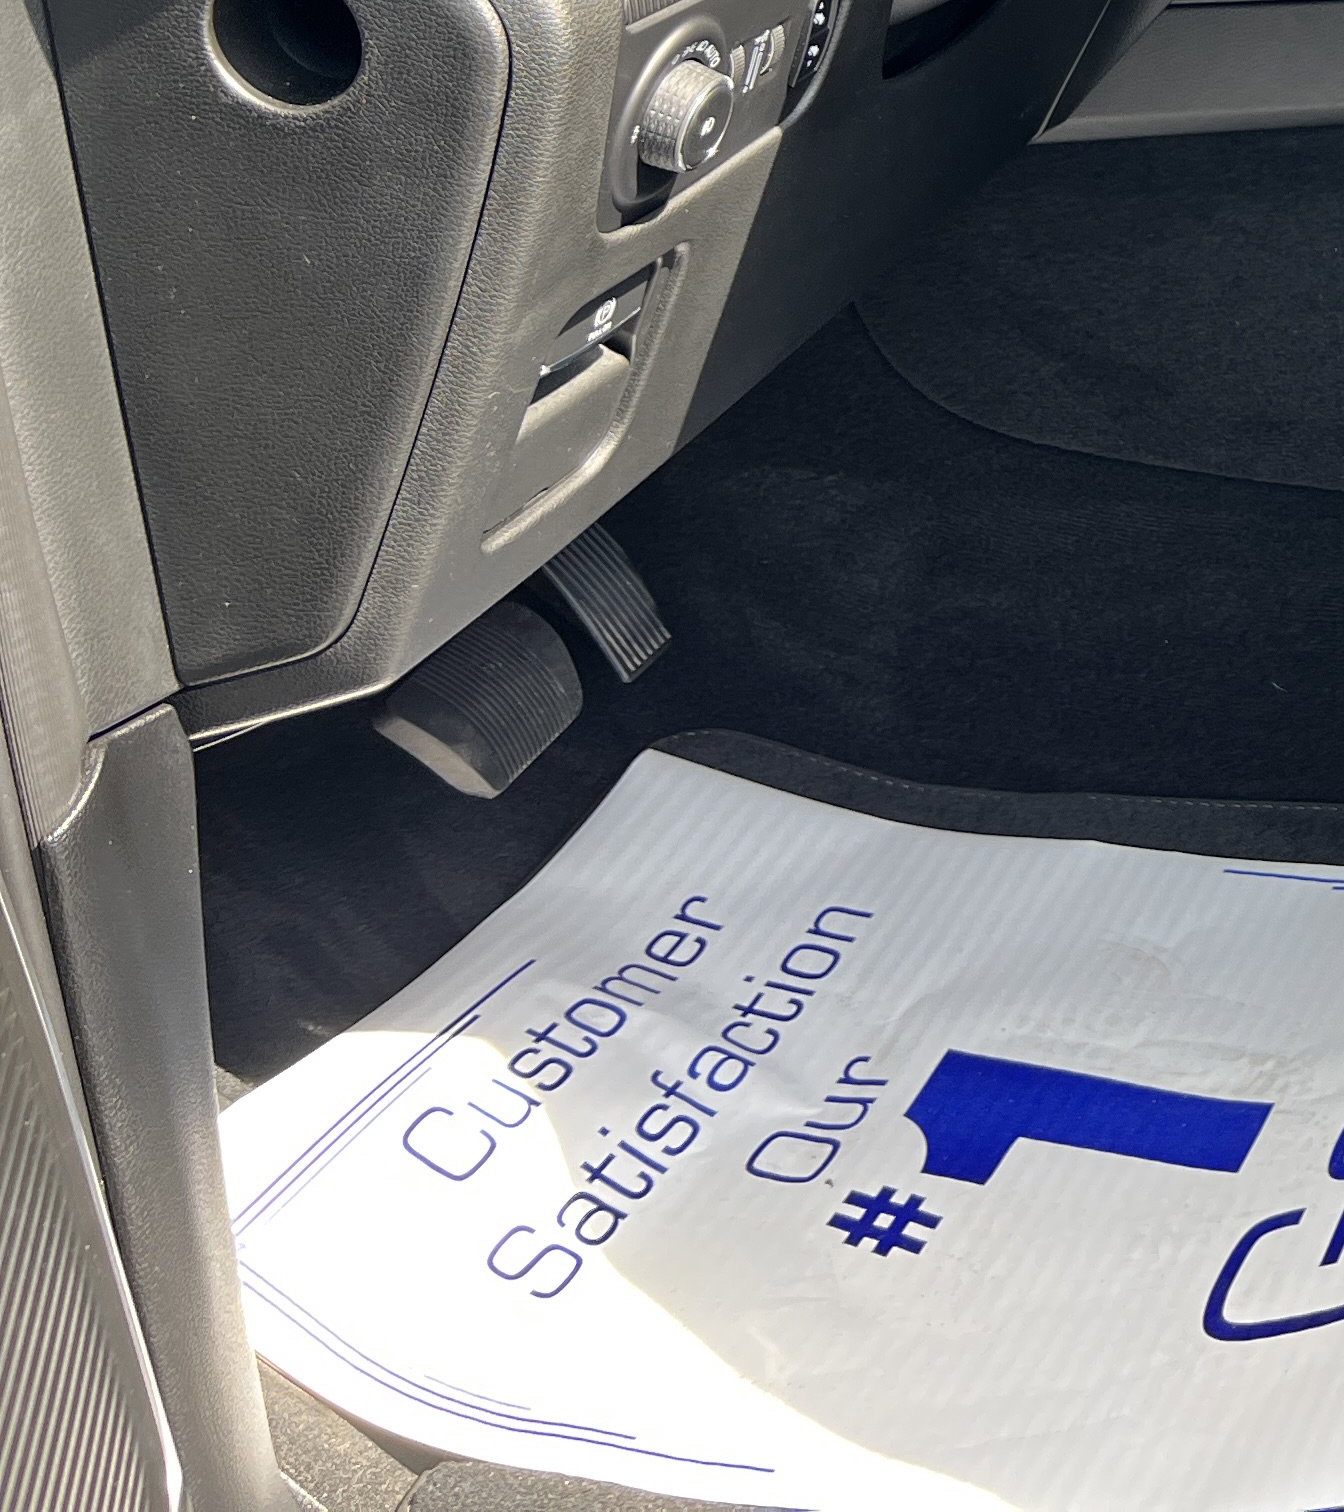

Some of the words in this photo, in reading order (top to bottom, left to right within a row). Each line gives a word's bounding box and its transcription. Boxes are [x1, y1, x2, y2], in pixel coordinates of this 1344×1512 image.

[402, 895, 724, 1181] Customer
[487, 905, 874, 1299] Satisfaction
[745, 1055, 889, 1184] Our
